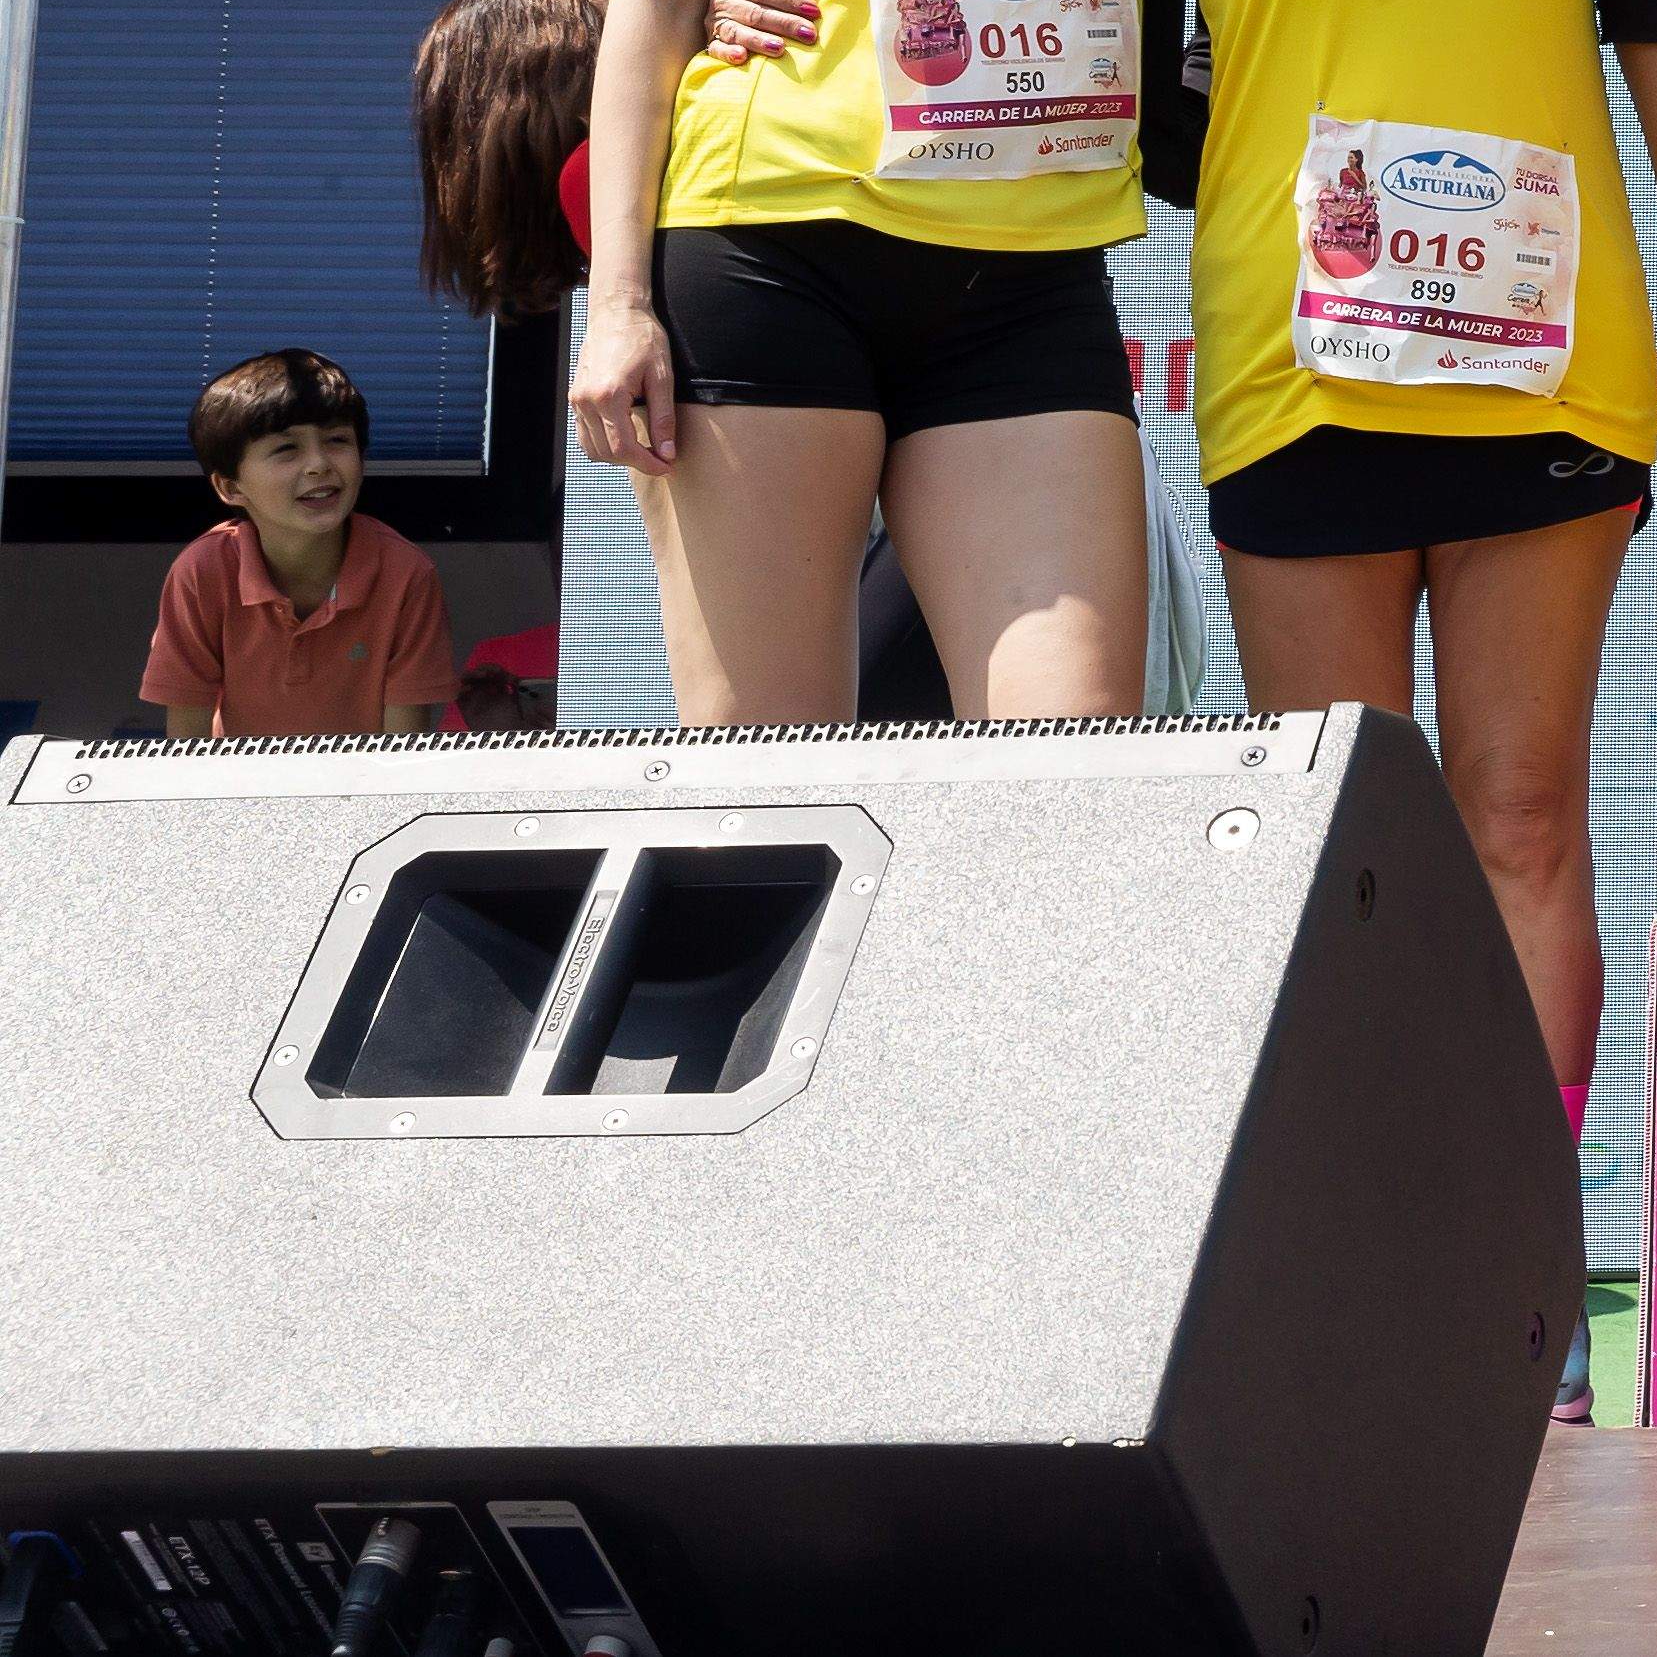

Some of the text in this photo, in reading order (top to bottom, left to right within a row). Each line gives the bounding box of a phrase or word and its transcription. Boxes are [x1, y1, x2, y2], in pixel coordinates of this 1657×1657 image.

[979, 22, 1063, 59] 016
[1006, 71, 1045, 93] 550
[918, 101, 1122, 124] CARRERA DE LA MUJER 2023
[908, 142, 995, 161] OYSHO
[1055, 134, 1115, 153] Santander
[1390, 167, 1496, 202] ASTURIANA
[1513, 177, 1560, 196] SUMA
[1515, 168, 1558, 183] TU DORSAL
[1389, 228, 1486, 272] 016
[1410, 279, 1456, 304] 899
[1322, 300, 1543, 343] CARRERA DE LA MUJER 2023
[1310, 335, 1391, 363] OYSHO
[1461, 356, 1550, 375] Santander
